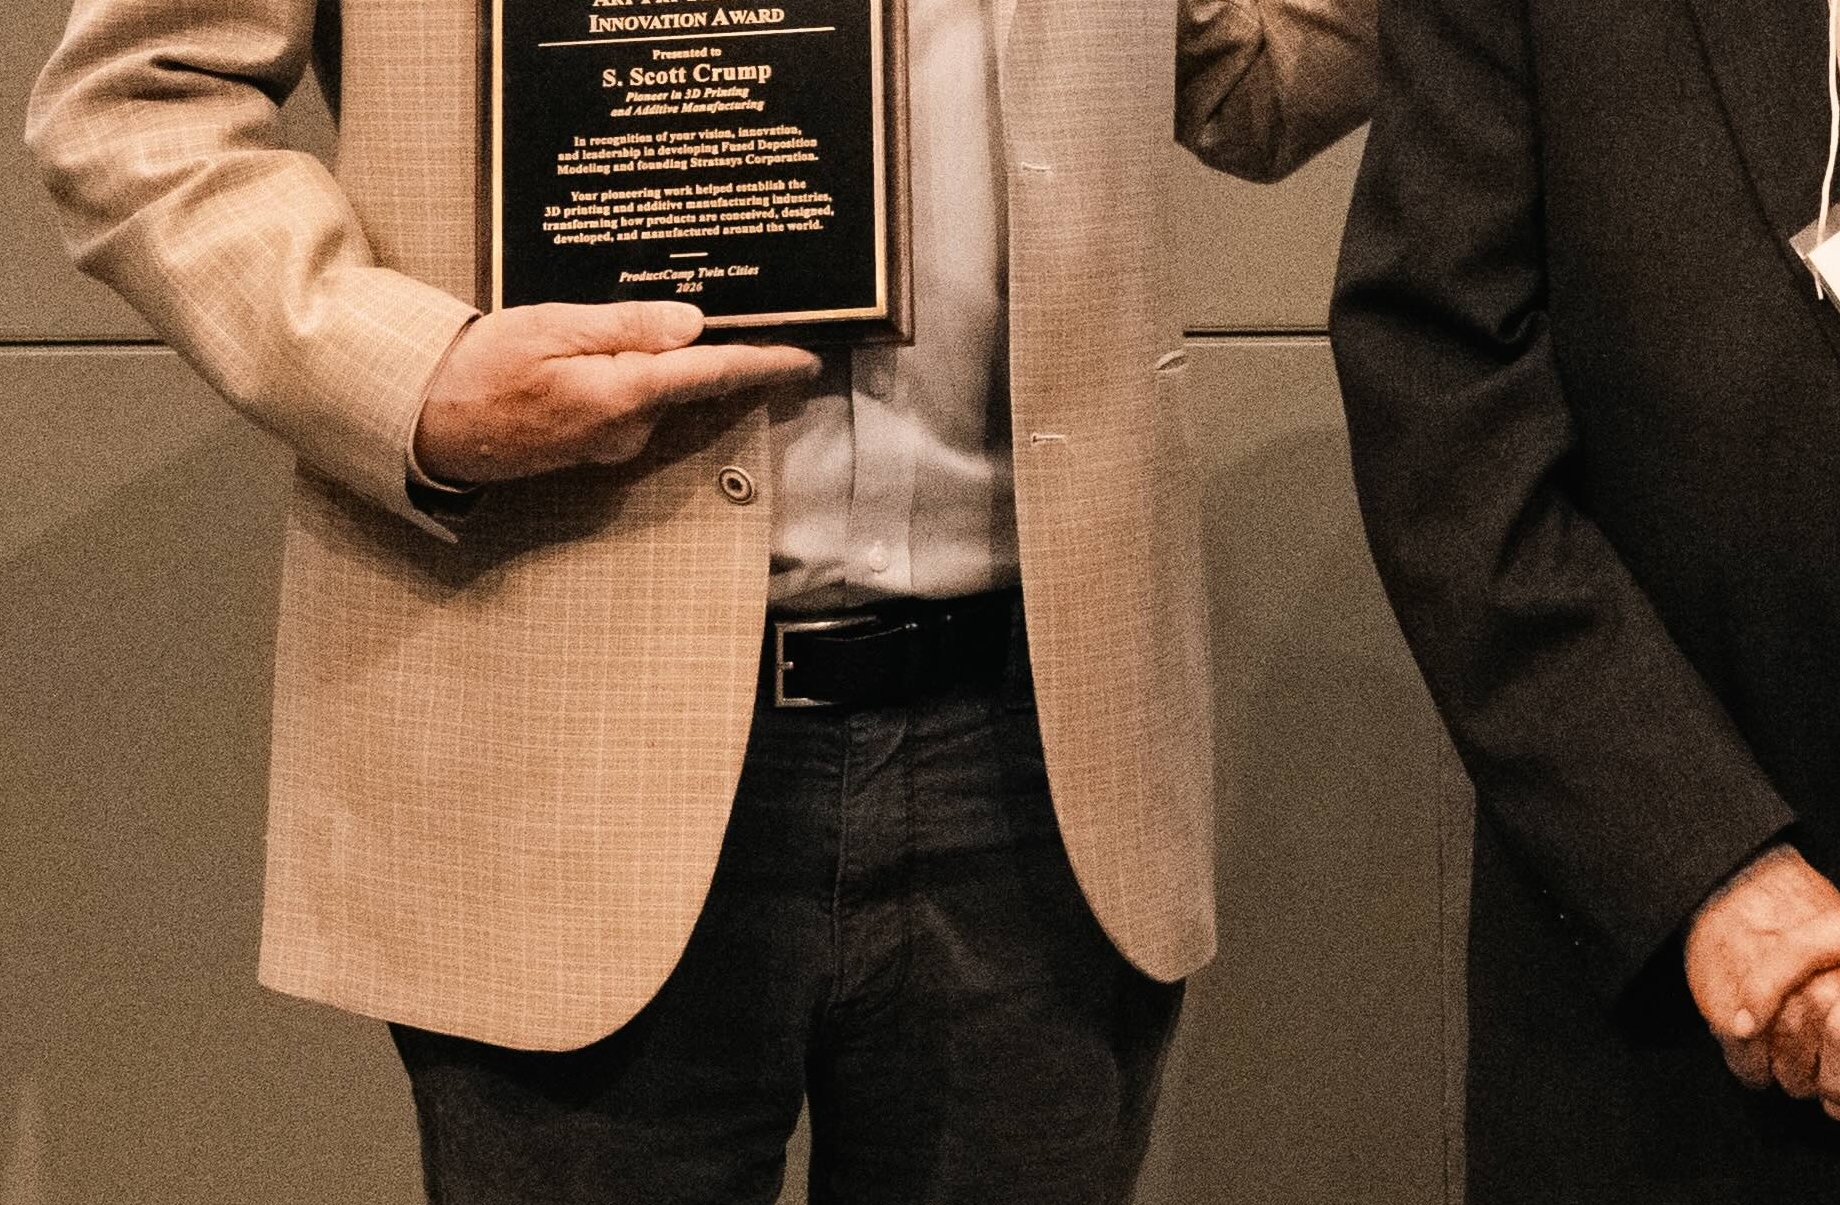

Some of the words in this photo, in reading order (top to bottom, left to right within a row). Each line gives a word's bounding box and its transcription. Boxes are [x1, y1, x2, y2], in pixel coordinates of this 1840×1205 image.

[588, 11, 708, 33] INNOVATION
[710, 7, 785, 27] AWARD
[652, 46, 708, 61] Presented
[709, 47, 723, 57] to
[602, 68, 623, 88] S.
[629, 66, 687, 87] Scott
[692, 63, 772, 84] Crump
[557, 150, 580, 161] and
[581, 147, 642, 160] leadership
[643, 146, 655, 157] in
[657, 143, 719, 157] developing
[721, 139, 755, 153] Fused
[757, 137, 818, 152] Deposition
[573, 136, 587, 147] In
[589, 133, 653, 147] recognition
[655, 131, 669, 143] of
[669, 131, 697, 144] your
[557, 163, 611, 175] Modeling
[613, 160, 635, 172] and
[636, 158, 688, 171] founding
[689, 157, 743, 168] Stratasys
[571, 191, 599, 202] Your
[600, 187, 662, 203] pioneering
[663, 185, 694, 197] work
[695, 182, 733, 197] helped
[735, 179, 786, 193] establish
[787, 178, 807, 190] the
[543, 206, 561, 217] 3D
[563, 204, 611, 219] printing
[612, 201, 635, 214] and
[636, 199, 683, 212] additive
[685, 195, 770, 209] manufacturing
[542, 217, 619, 231] transforming
[620, 216, 645, 227] how
[646, 213, 697, 228] products
[698, 213, 718, 223] are
[616, 229, 638, 241] and
[640, 225, 720, 240] manufactured
[722, 222, 764, 235] around
[765, 221, 785, 233] the
[675, 281, 703, 293] 2026
